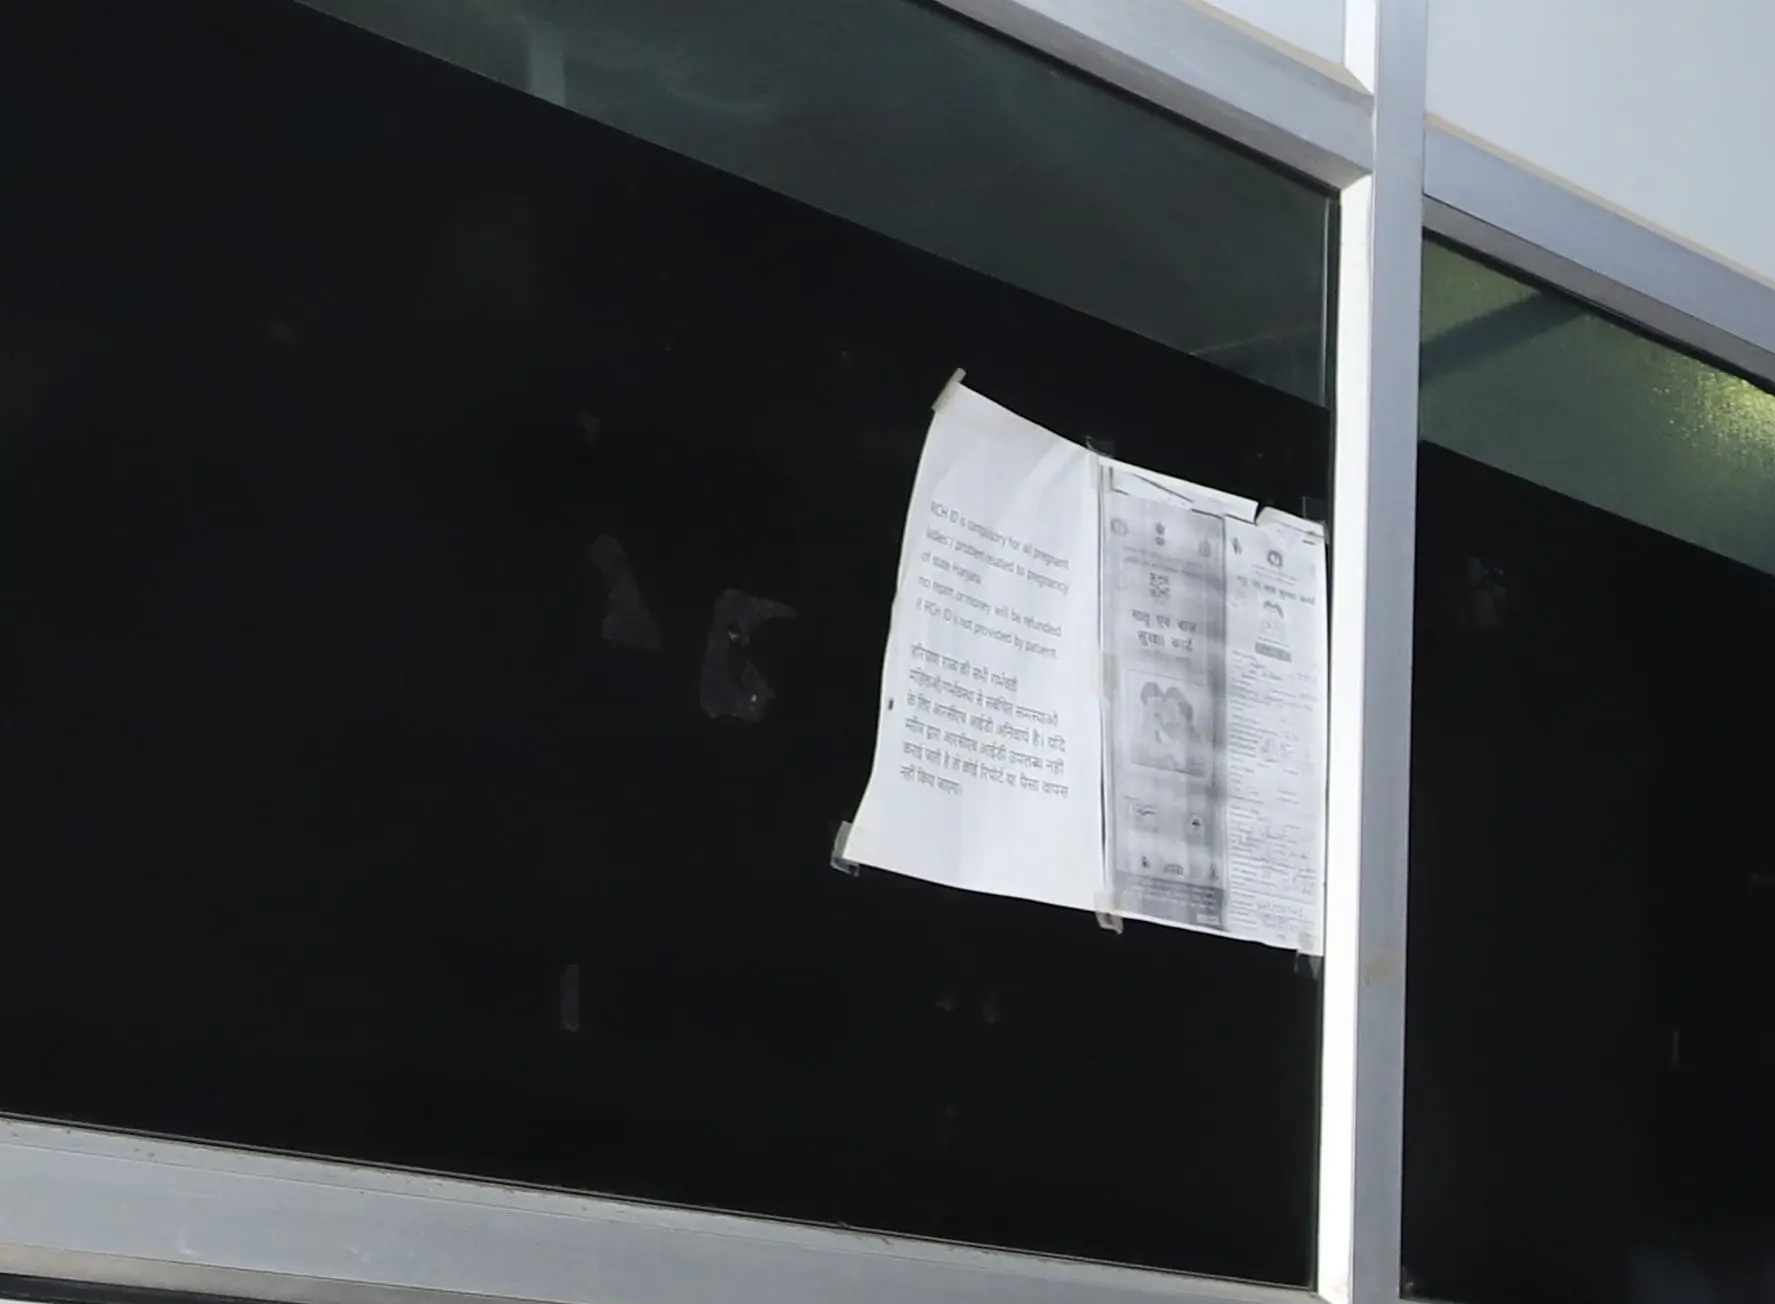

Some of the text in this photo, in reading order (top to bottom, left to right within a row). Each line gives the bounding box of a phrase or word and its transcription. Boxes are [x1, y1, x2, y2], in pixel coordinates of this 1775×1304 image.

[1008, 536, 1019, 551] for
[1032, 548, 1069, 569] pregnant
[1016, 564, 1025, 575] to
[1026, 569, 1068, 596] pregnancy
[1011, 608, 1021, 624] be
[1023, 615, 1061, 637] refunded
